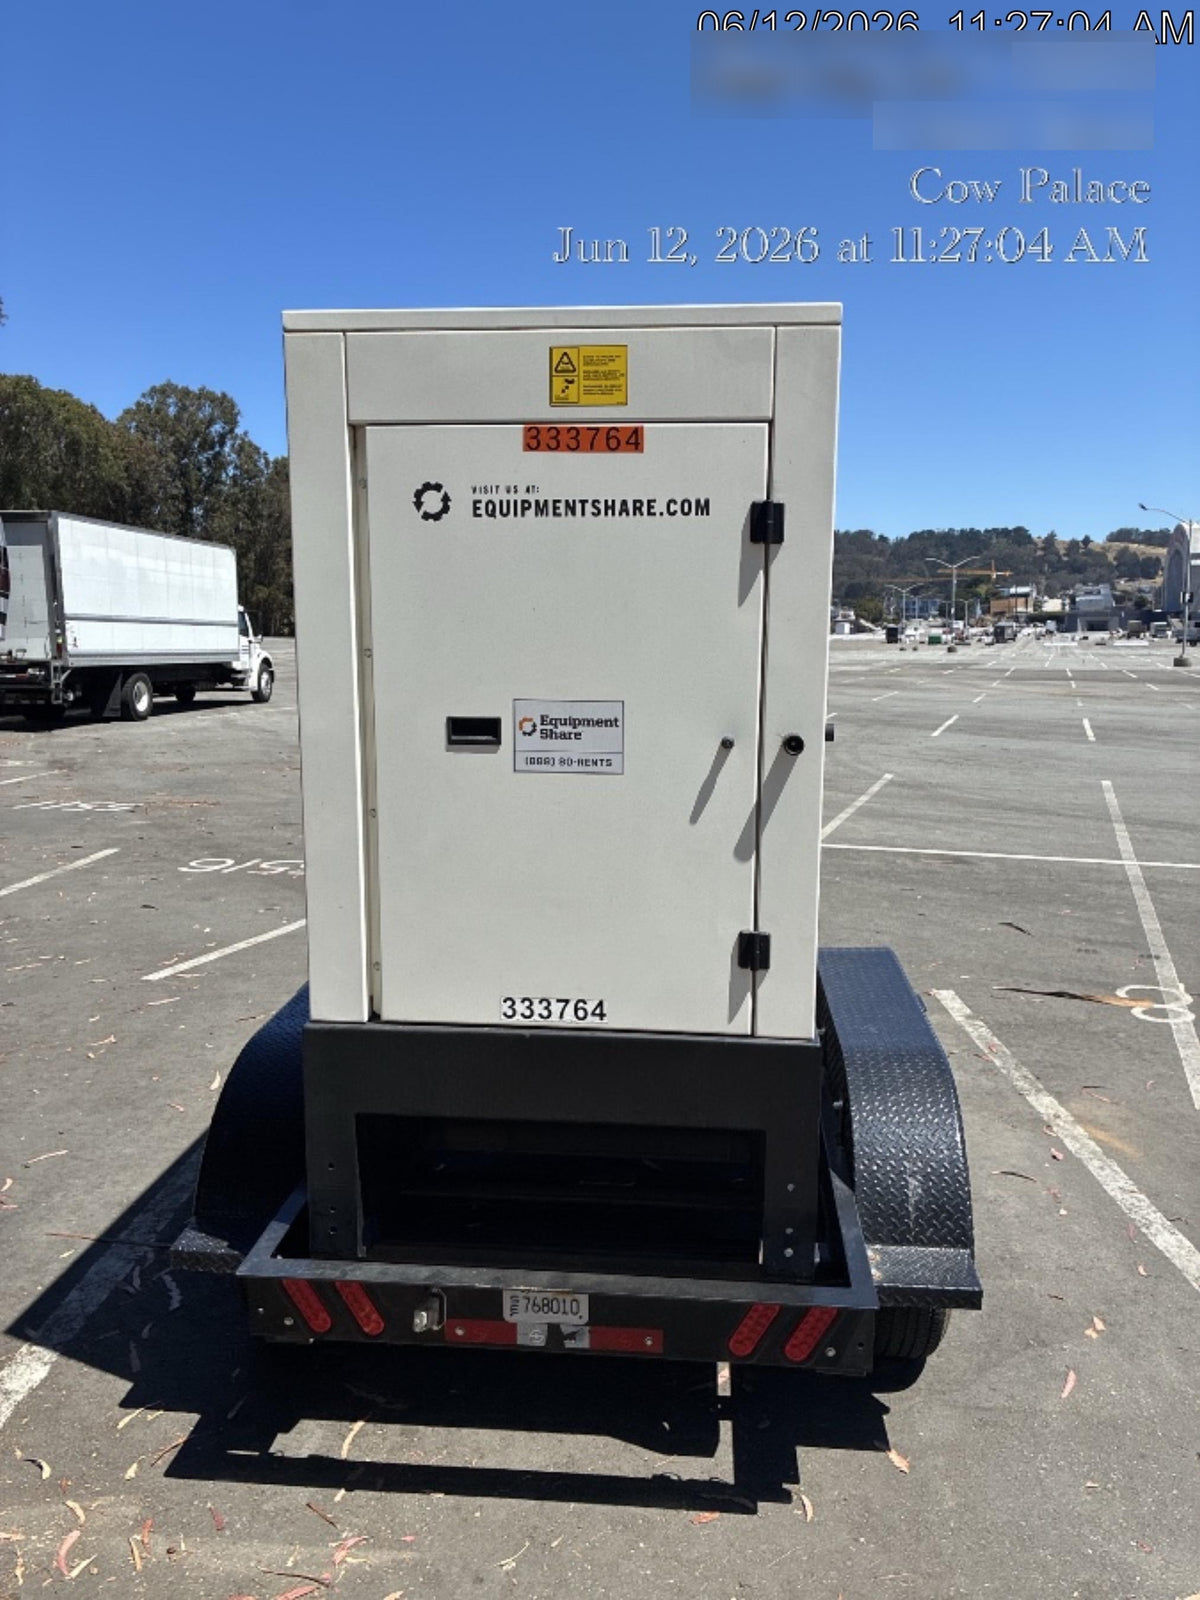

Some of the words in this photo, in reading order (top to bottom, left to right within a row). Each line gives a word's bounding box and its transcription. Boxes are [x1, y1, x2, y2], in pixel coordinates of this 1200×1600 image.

[526, 426, 641, 451] 333764
[471, 484, 500, 495] VISIT
[505, 484, 519, 495] US
[525, 484, 541, 495] AT:
[472, 498, 710, 519] EQUIPMENTSHARE.COM
[540, 714, 620, 730] Equipment
[540, 728, 583, 741] Share
[502, 996, 607, 1021] 333764
[522, 1295, 580, 1317] 768010
